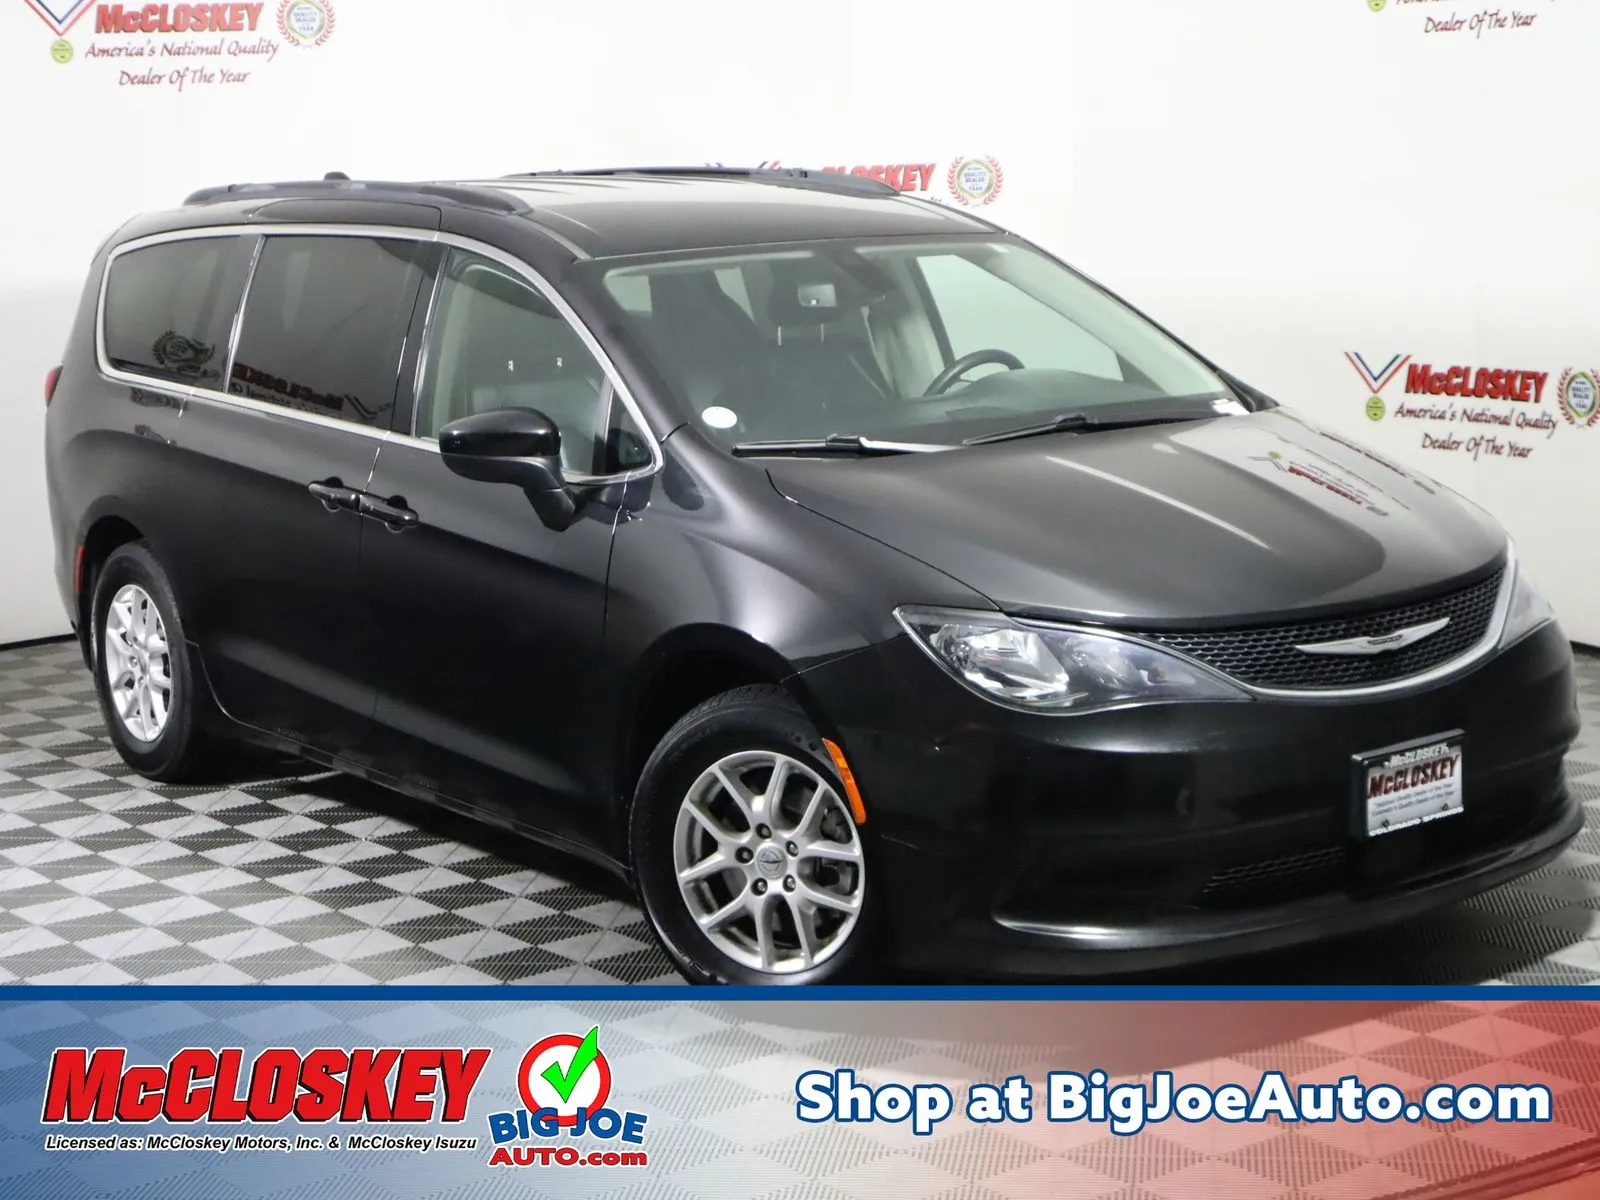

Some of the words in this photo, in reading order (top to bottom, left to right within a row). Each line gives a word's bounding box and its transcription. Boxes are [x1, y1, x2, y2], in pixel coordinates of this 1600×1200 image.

[94, 2, 265, 34] McCLOSKEY
[1424, 13, 1466, 33] Dealer
[1469, 10, 1487, 38] Of
[1488, 9, 1508, 29] The
[1511, 11, 1537, 29] Year
[85, 38, 155, 58] America's
[160, 35, 223, 57] National
[227, 37, 279, 61] Quality
[119, 68, 165, 86] Dealer
[169, 66, 189, 92] Of
[190, 68, 215, 84] The
[219, 67, 250, 84] Year
[1405, 363, 1549, 403] McCLOSKEY
[1394, 402, 1457, 422] America's
[1460, 407, 1514, 427] National
[1515, 409, 1558, 439] Quality
[1421, 433, 1464, 452] Dealer
[1466, 434, 1484, 461] Of
[1484, 435, 1505, 457] The
[1506, 438, 1534, 458] Year
